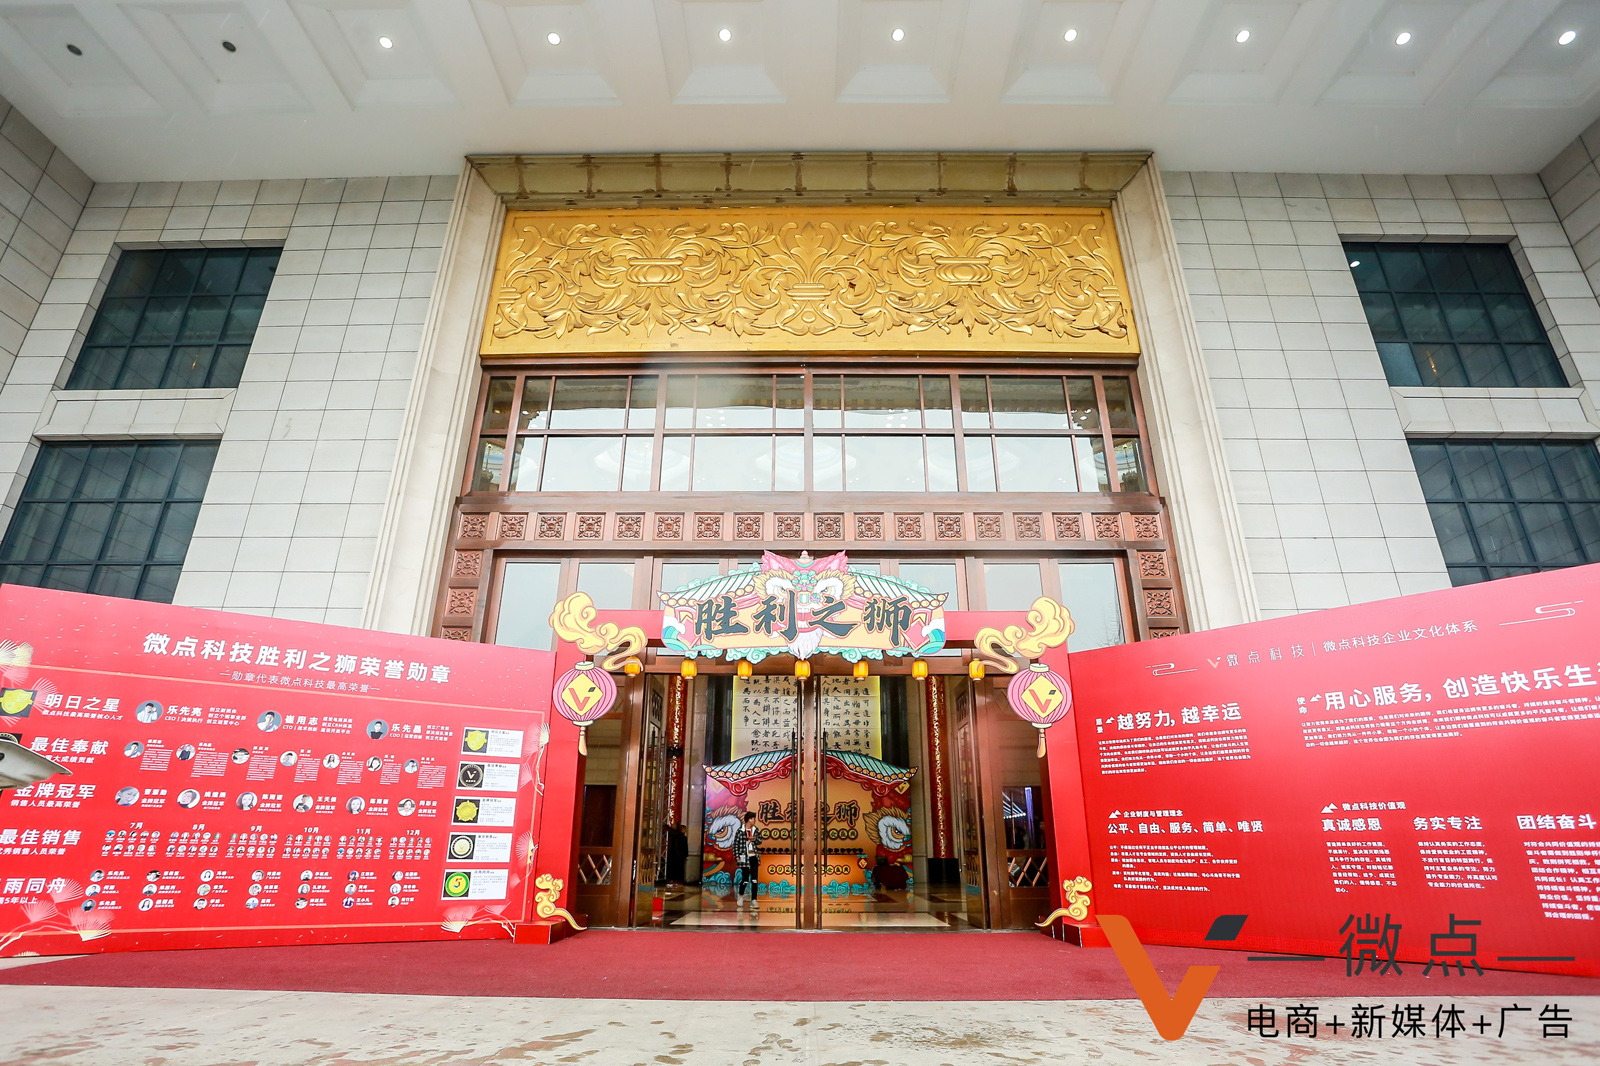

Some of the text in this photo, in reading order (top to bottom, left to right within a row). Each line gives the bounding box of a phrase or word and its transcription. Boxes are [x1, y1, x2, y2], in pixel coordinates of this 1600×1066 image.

[694, 590, 915, 646] 胜利之狮
[1323, 619, 1478, 653] 微点科技企业文化体系
[142, 631, 451, 684] 微点科技胜利之狮荣誉勋章
[1226, 642, 1305, 668] 微点科技
[1296, 662, 1600, 714] 使命 用心服务，创造快乐生
[44, 692, 121, 713] 明日之星
[164, 715, 176, 723] CEO
[282, 723, 294, 731] CTO
[30, 735, 110, 756] 最佳奉献
[13, 782, 97, 801] 金牌冠军
[1123, 810, 1183, 818] 企业制度与管理理念
[1342, 801, 1406, 812] 微点科技价值观
[129, 822, 144, 830] 7月
[191, 823, 206, 832] 8月
[250, 825, 264, 833] 9月
[1107, 820, 1264, 834] 公平、自由、服务、简单、唯贤
[1321, 817, 1383, 833] 真诚感恩
[1413, 816, 1483, 831] 务实专注
[1516, 813, 1597, 830] 团结奋斗
[303, 826, 320, 834] 10月
[355, 828, 372, 836] 11月
[406, 829, 421, 837] 12月
[0, 828, 82, 848] 最佳销售
[0, 876, 67, 895] 雨同舟
